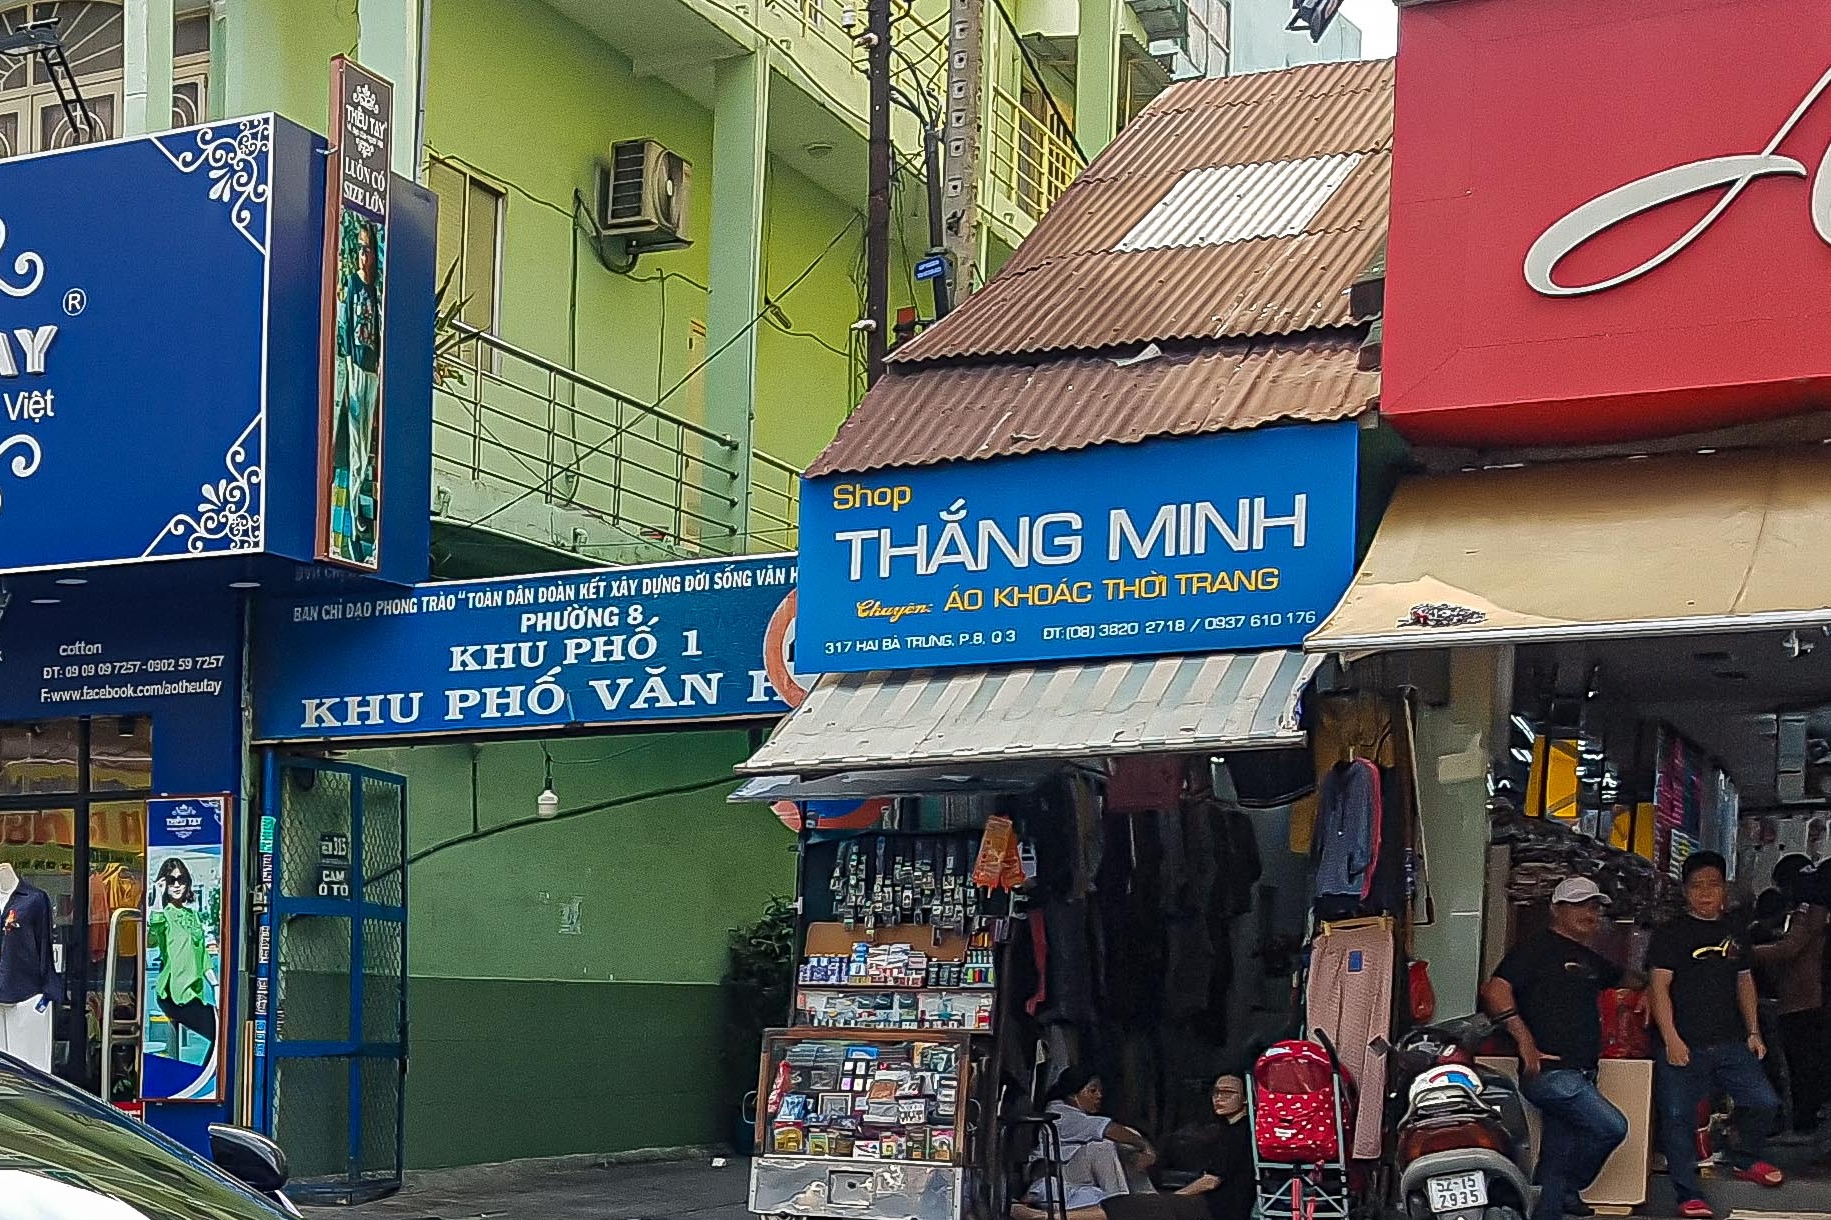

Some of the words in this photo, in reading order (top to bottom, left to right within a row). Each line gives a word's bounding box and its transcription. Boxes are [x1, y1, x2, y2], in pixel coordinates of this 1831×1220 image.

[343, 180, 365, 206] SIZE
[372, 171, 385, 192] CÓ
[3, 389, 55, 424] Việt
[832, 483, 913, 512] Shop
[834, 498, 1083, 582] THẮNG
[1107, 493, 1309, 563] MINH
[293, 606, 318, 623] BAN
[375, 597, 418, 617] PHONG
[421, 590, 456, 613] TRÀO
[506, 585, 535, 606] DÂN
[579, 576, 607, 600] KẾT
[610, 577, 637, 597] XÂY
[642, 574, 682, 598] DỰNG
[684, 569, 710, 592] ĐỜI
[714, 562, 752, 588] SỐNG
[757, 565, 785, 585] VĂN
[855, 597, 932, 624] Chuyên:
[943, 580, 983, 613] ÁO
[992, 576, 1094, 608] KHOÁC
[1101, 569, 1168, 601] THỜI
[1178, 566, 1280, 596] TRANG
[520, 603, 619, 633] PHƯỜNG
[627, 604, 644, 625] 8
[1098, 622, 1139, 637] 3820
[1145, 619, 1186, 634] 2718
[1205, 615, 1246, 630] 0937
[1250, 613, 1282, 628] 610
[1286, 610, 1316, 625] 176
[59, 640, 102, 657] cotton
[449, 640, 547, 673] KHU
[562, 615, 661, 666] PHỐ
[681, 629, 704, 657] 1
[824, 641, 852, 655] 317
[856, 639, 879, 652] HAI
[882, 634, 901, 650] BÀ
[65, 664, 79, 678] 09
[81, 663, 95, 677] 09
[98, 662, 111, 676] 09
[178, 657, 192, 671] 59
[196, 655, 225, 670] 7257
[300, 692, 424, 728] KHU
[444, 665, 567, 721] PHỐ
[588, 667, 725, 709] VĂN
